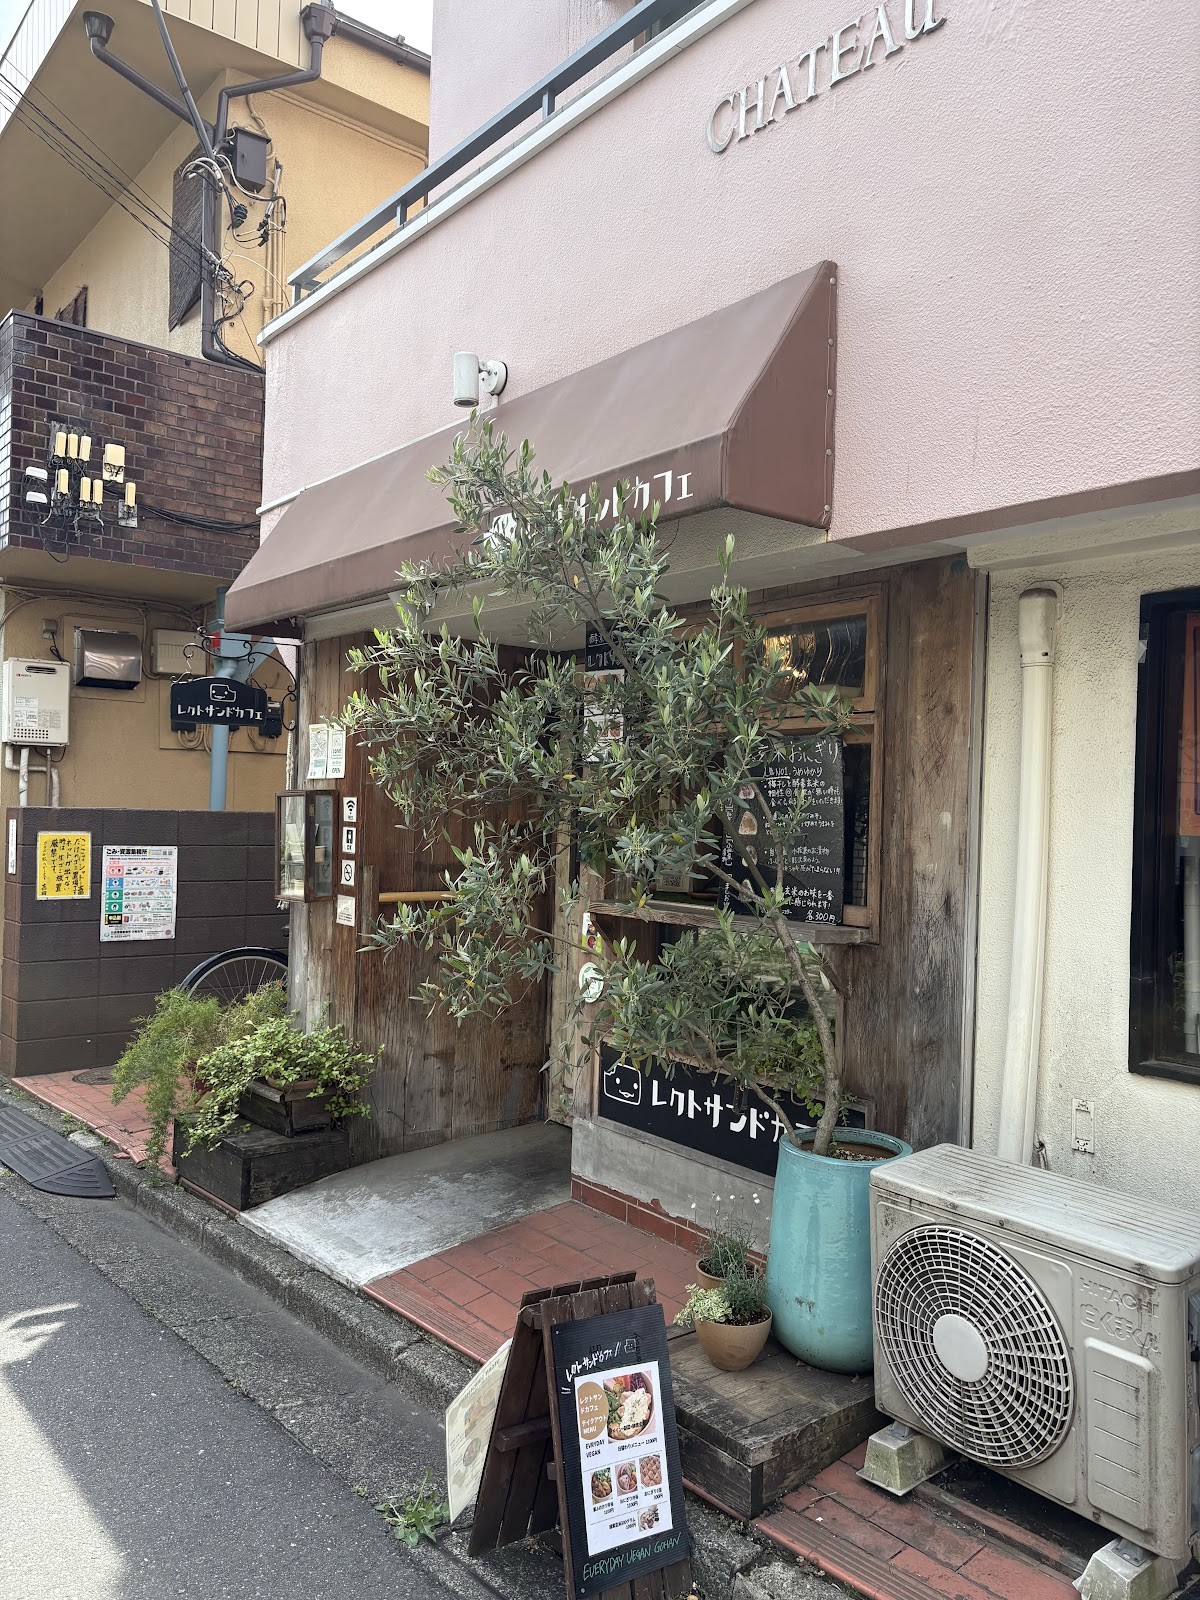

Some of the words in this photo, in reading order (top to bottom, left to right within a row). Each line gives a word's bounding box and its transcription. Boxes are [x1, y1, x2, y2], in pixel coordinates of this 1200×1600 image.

[706, 0, 947, 154] CHATEAU
[177, 704, 263, 720] レクトサンドカフェ
[651, 1079, 816, 1143] レクトサンドカ
[1079, 1277, 1160, 1319] HITACHI
[585, 1449, 601, 1458] VEGAN
